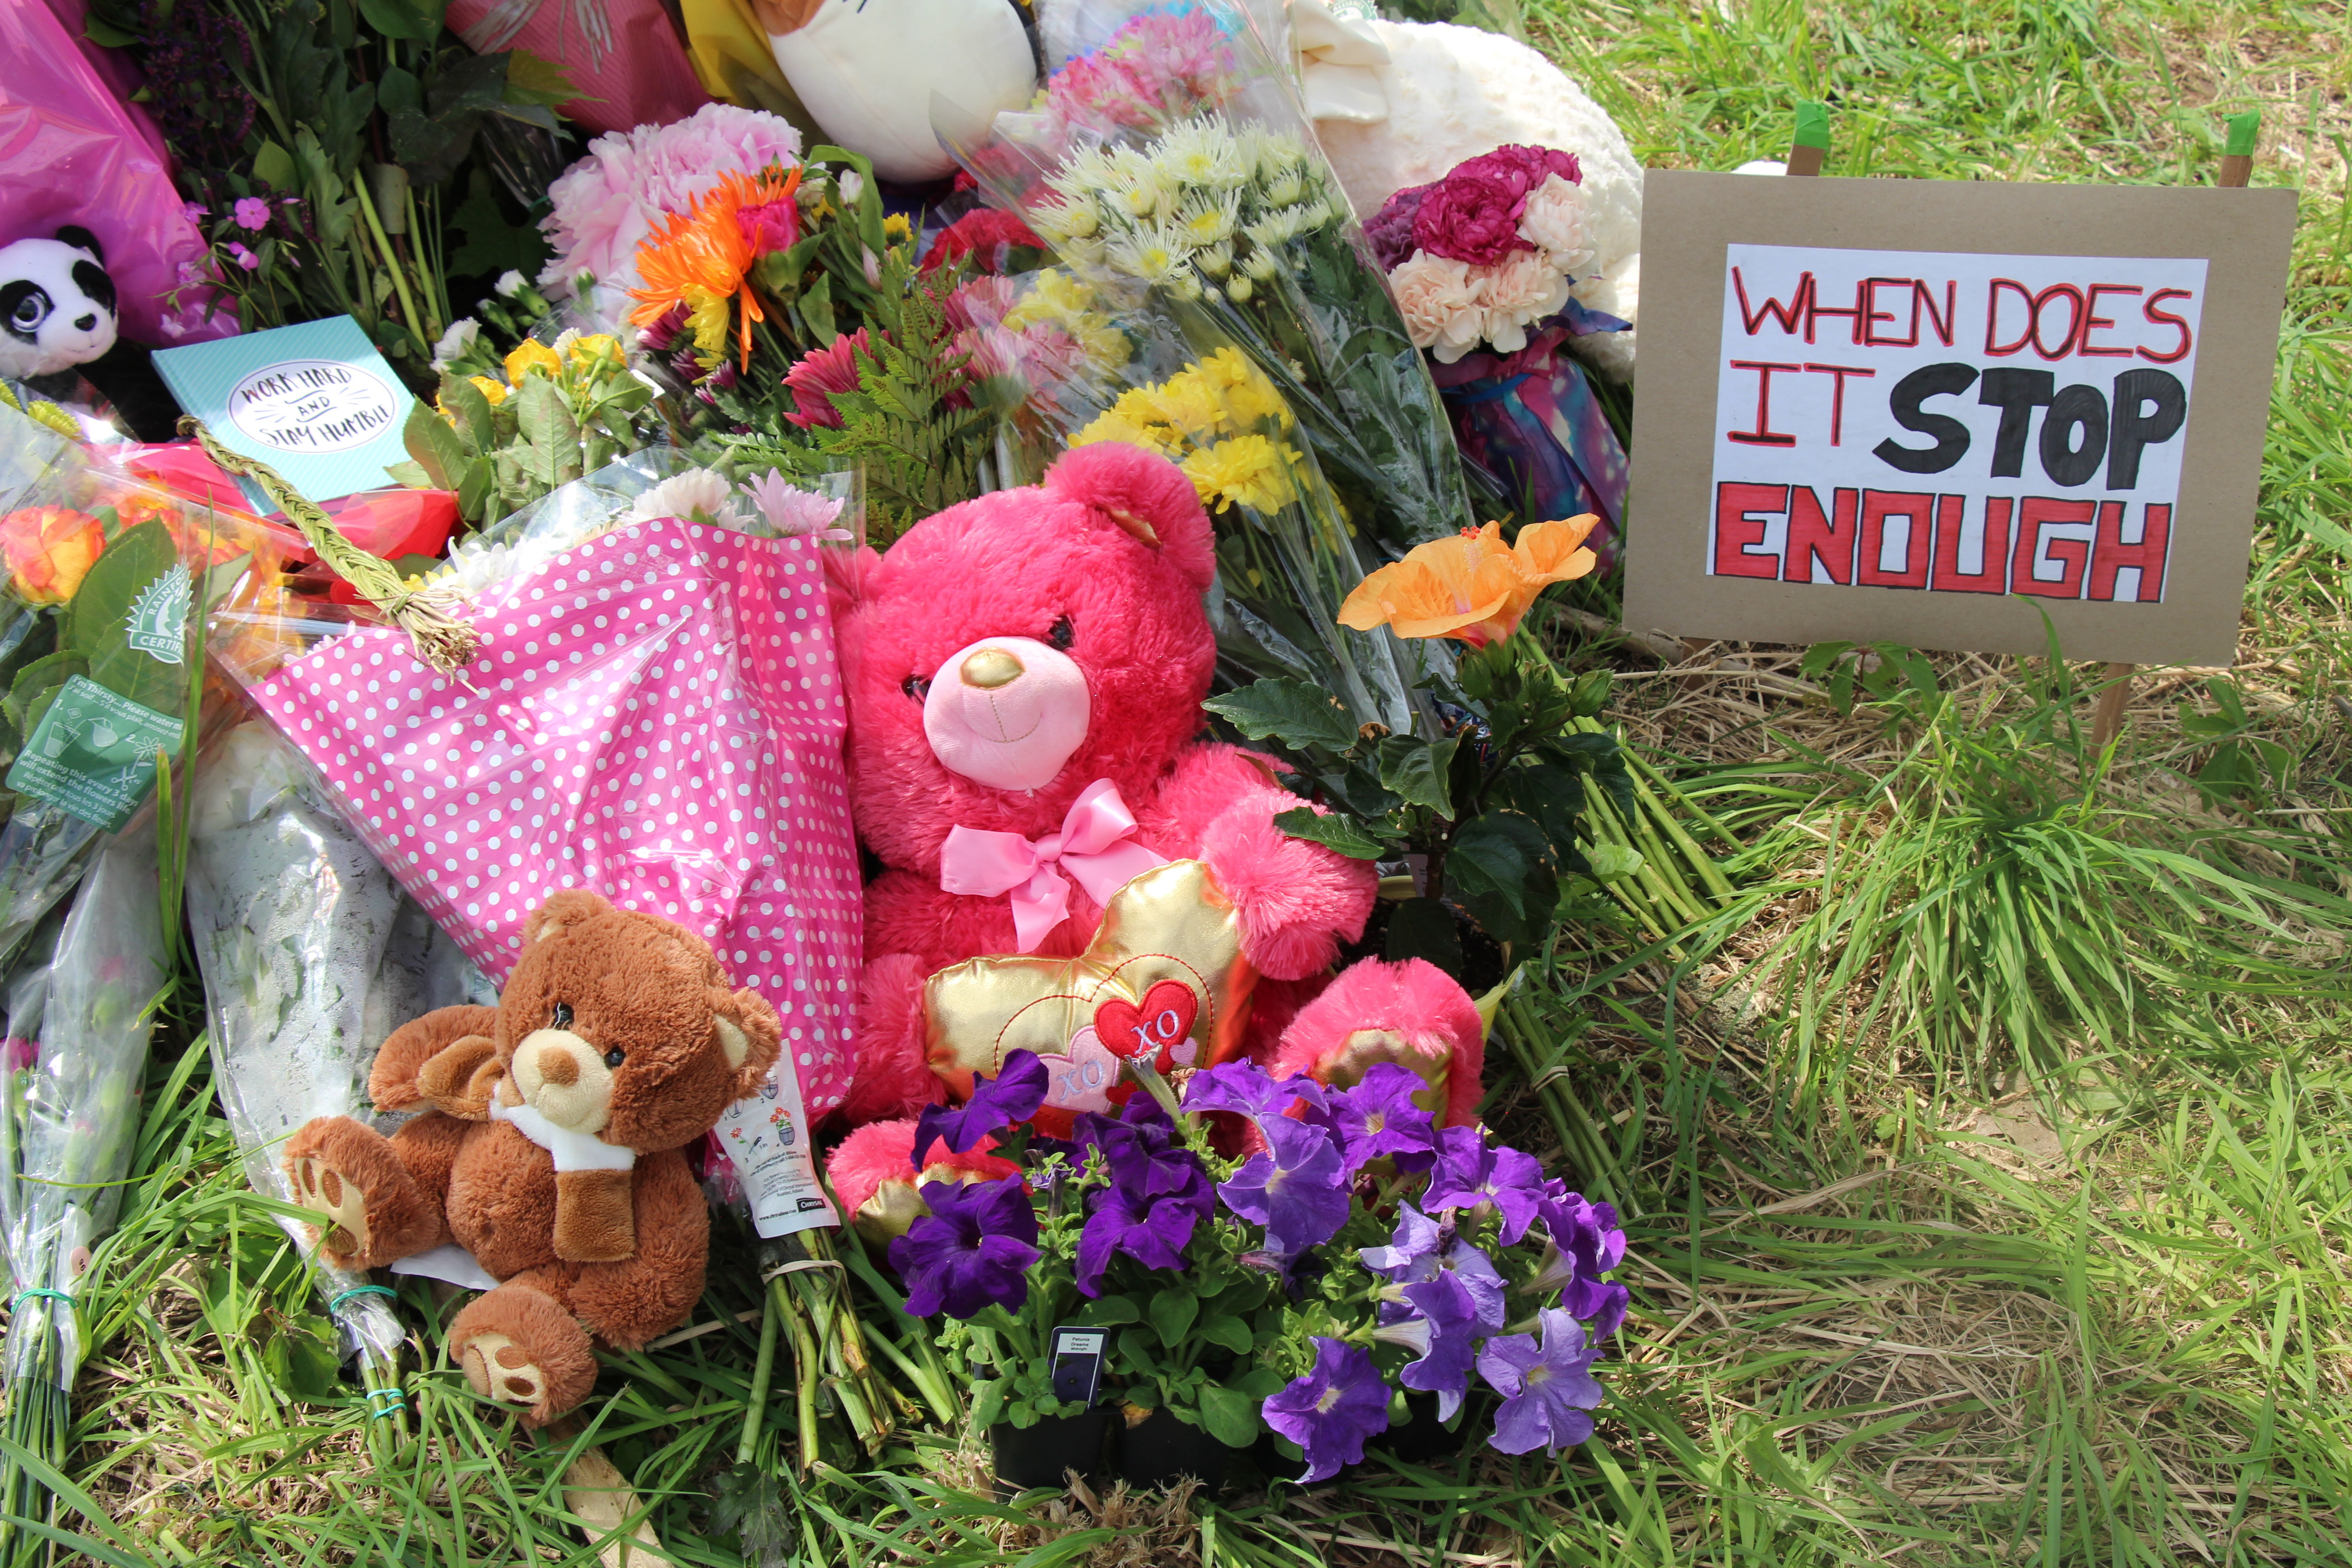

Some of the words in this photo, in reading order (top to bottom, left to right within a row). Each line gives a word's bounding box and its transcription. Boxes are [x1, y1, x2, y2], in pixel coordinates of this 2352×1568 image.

[1333, 0, 1365, 11] ALLIANCE
[1731, 266, 1957, 347] WHEN
[1984, 278, 2192, 364] DOES
[240, 372, 299, 403] WORK
[296, 368, 351, 387] HARD
[298, 397, 329, 416] AND
[260, 426, 317, 446] STAY
[317, 404, 390, 441] HUMBLE
[1728, 360, 1876, 447] IT
[1872, 363, 2187, 491] STOP
[1714, 482, 2172, 603] ENOUGH
[55, 699, 63, 710] 1.
[68, 685, 82, 694] J'ai
[99, 700, 111, 709] S'il
[110, 707, 127, 717] vous
[73, 676, 87, 688] I'm
[122, 702, 150, 717] Please
[149, 714, 173, 727] water
[125, 734, 135, 743] 2.
[19, 760, 37, 769] will
[36, 766, 68, 783] extend
[67, 779, 83, 790] the
[83, 786, 116, 806] flowers
[117, 802, 131, 814] life.
[24, 750, 69, 774] Repeating
[69, 769, 87, 781] this
[87, 779, 113, 794] every
[120, 794, 139, 806] days
[24, 785, 60, 802] prolonger
[78, 809, 92, 818] des
[92, 813, 111, 828] fleurs.
[51, 785, 65, 794] cela
[66, 791, 81, 802] tous
[82, 798, 92, 807] les
[96, 805, 116, 818] jours
[1130, 1009, 1179, 1055] XO
[1056, 1059, 1103, 1101] XO
[800, 1200, 823, 1208] CHRYSAL
